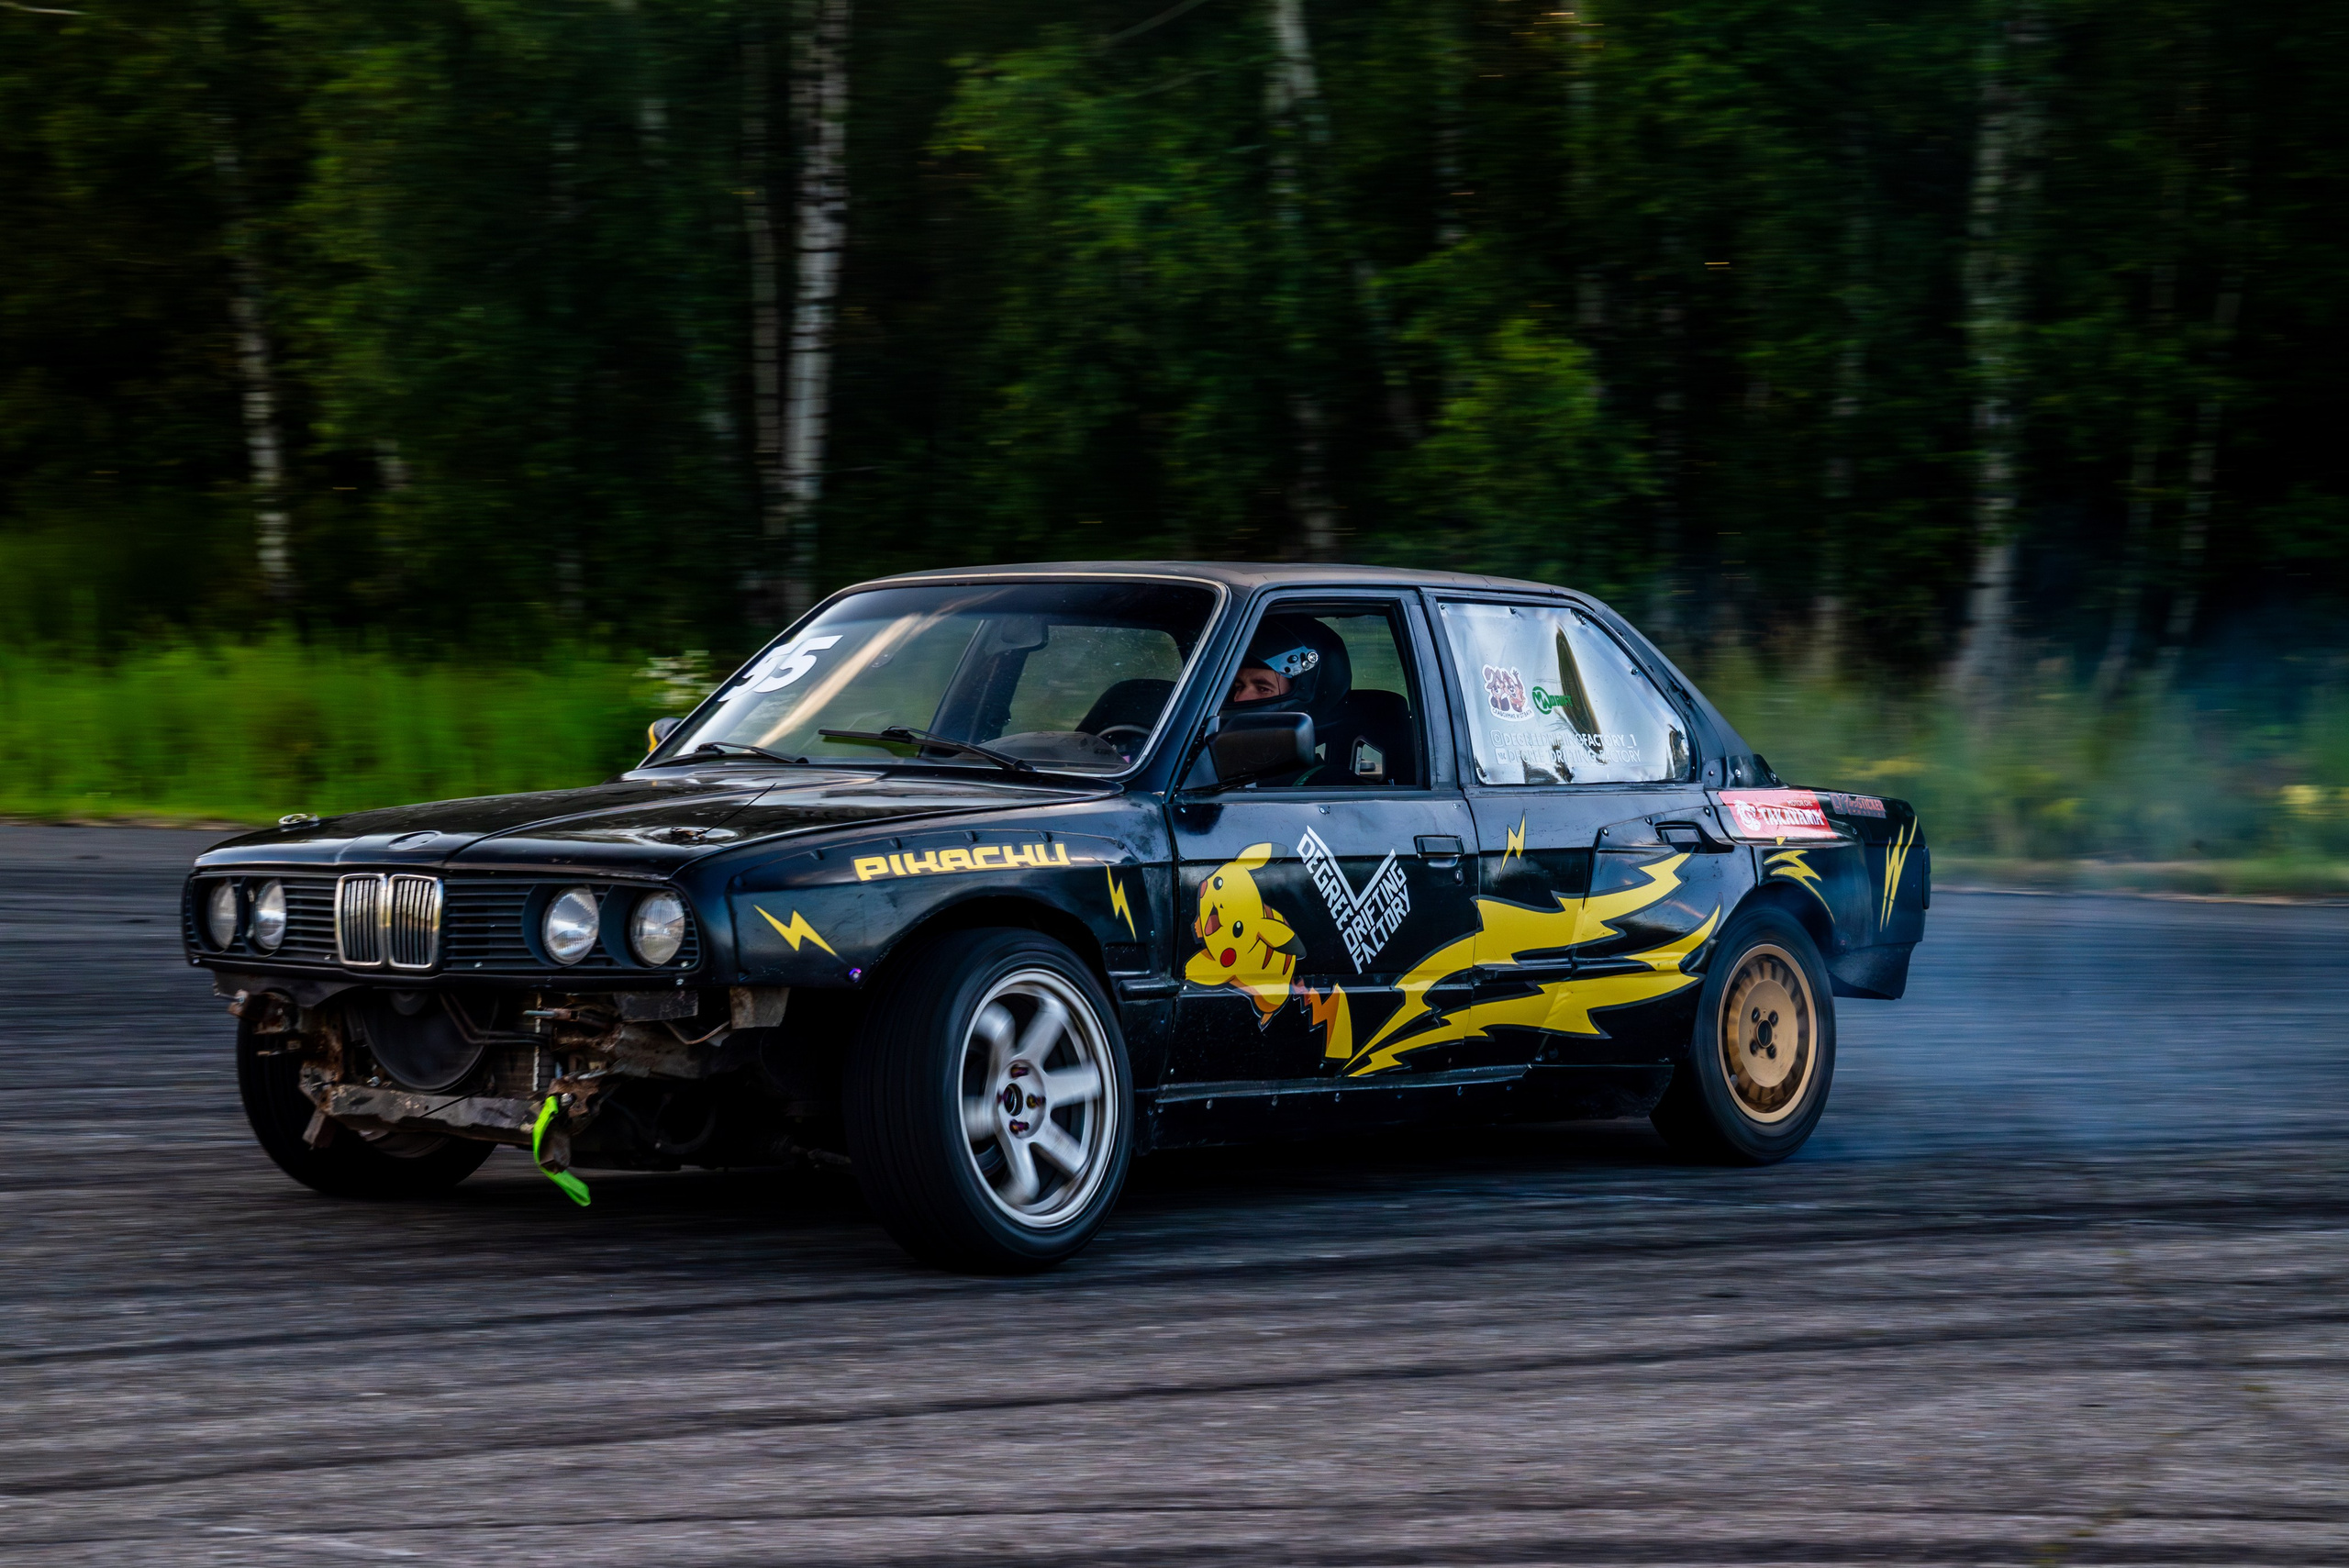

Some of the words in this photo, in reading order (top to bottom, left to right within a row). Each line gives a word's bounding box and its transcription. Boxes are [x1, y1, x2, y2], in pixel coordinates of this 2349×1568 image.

[853, 843, 1072, 881] PIKACHU
[1759, 808, 1824, 826] TAKAYAMA
[1297, 833, 1353, 930] DEGREE
[1342, 860, 1407, 954] DRIFTING
[1352, 884, 1410, 974] FACTORY
